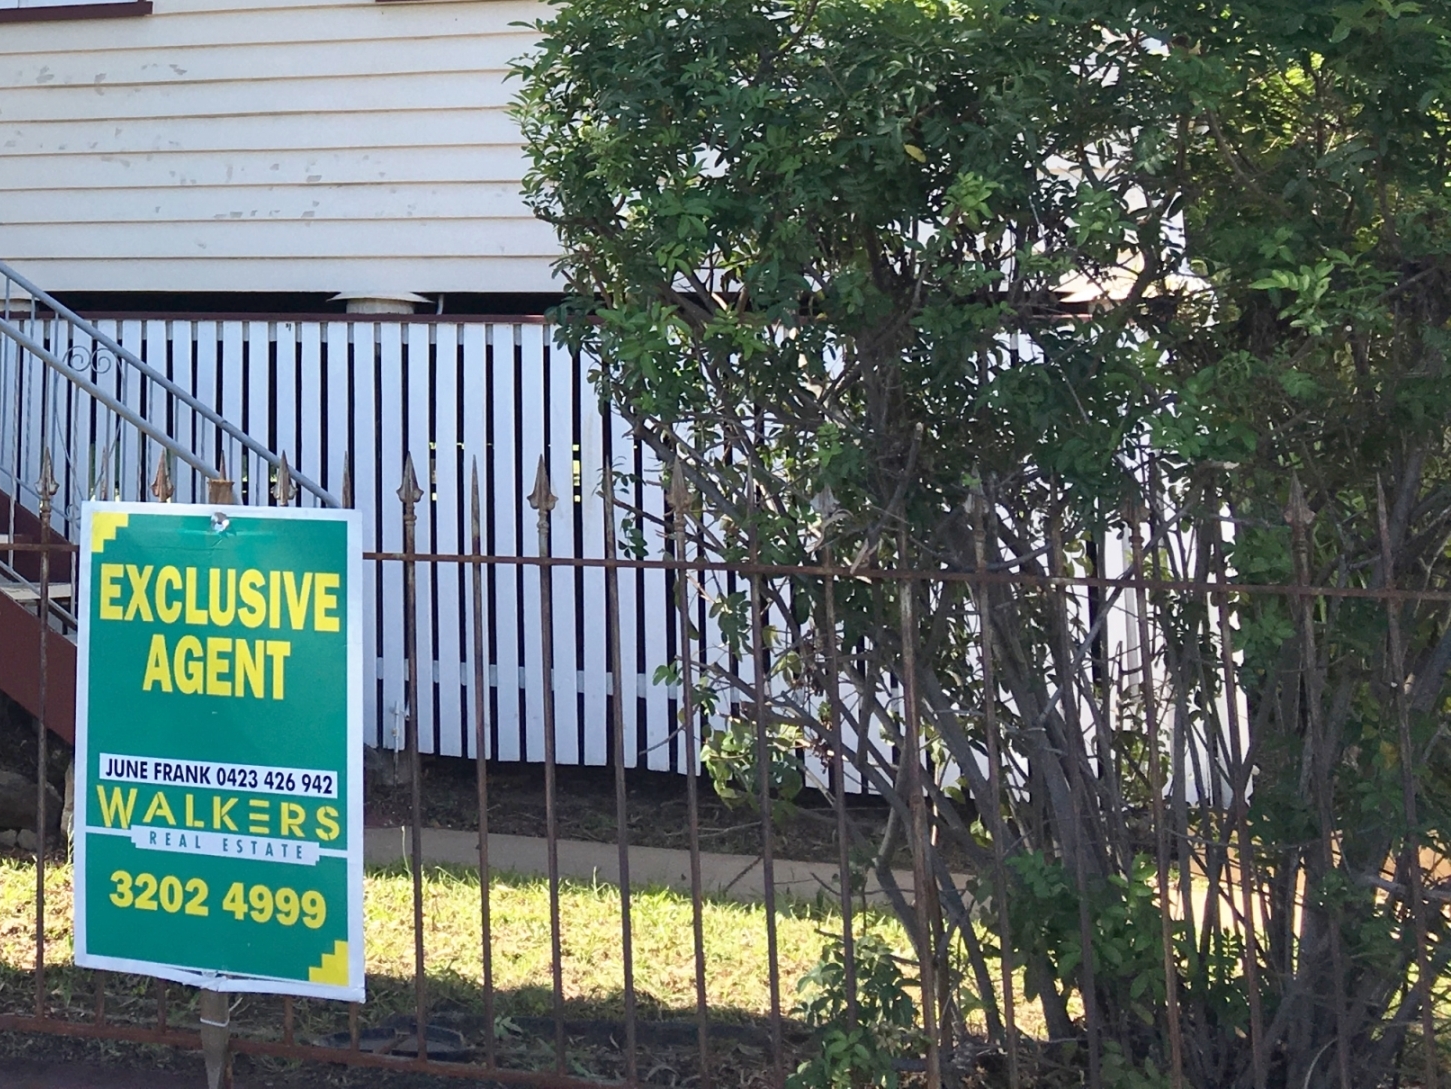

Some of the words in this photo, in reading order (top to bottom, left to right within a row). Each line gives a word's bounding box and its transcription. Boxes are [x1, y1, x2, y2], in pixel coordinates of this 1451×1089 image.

[99, 563, 340, 633] EXCLUSIVE
[143, 634, 292, 700] AGENT
[105, 758, 148, 781] JUNE
[153, 762, 211, 786] FRANK
[216, 767, 259, 789] 0423
[264, 771, 296, 792] 426
[301, 773, 333, 795] 942
[96, 785, 341, 841] WALKERS
[149, 830, 202, 850] REAL
[223, 839, 304, 861] ESTATE
[109, 869, 210, 917] 3202
[222, 882, 327, 929] 4999
